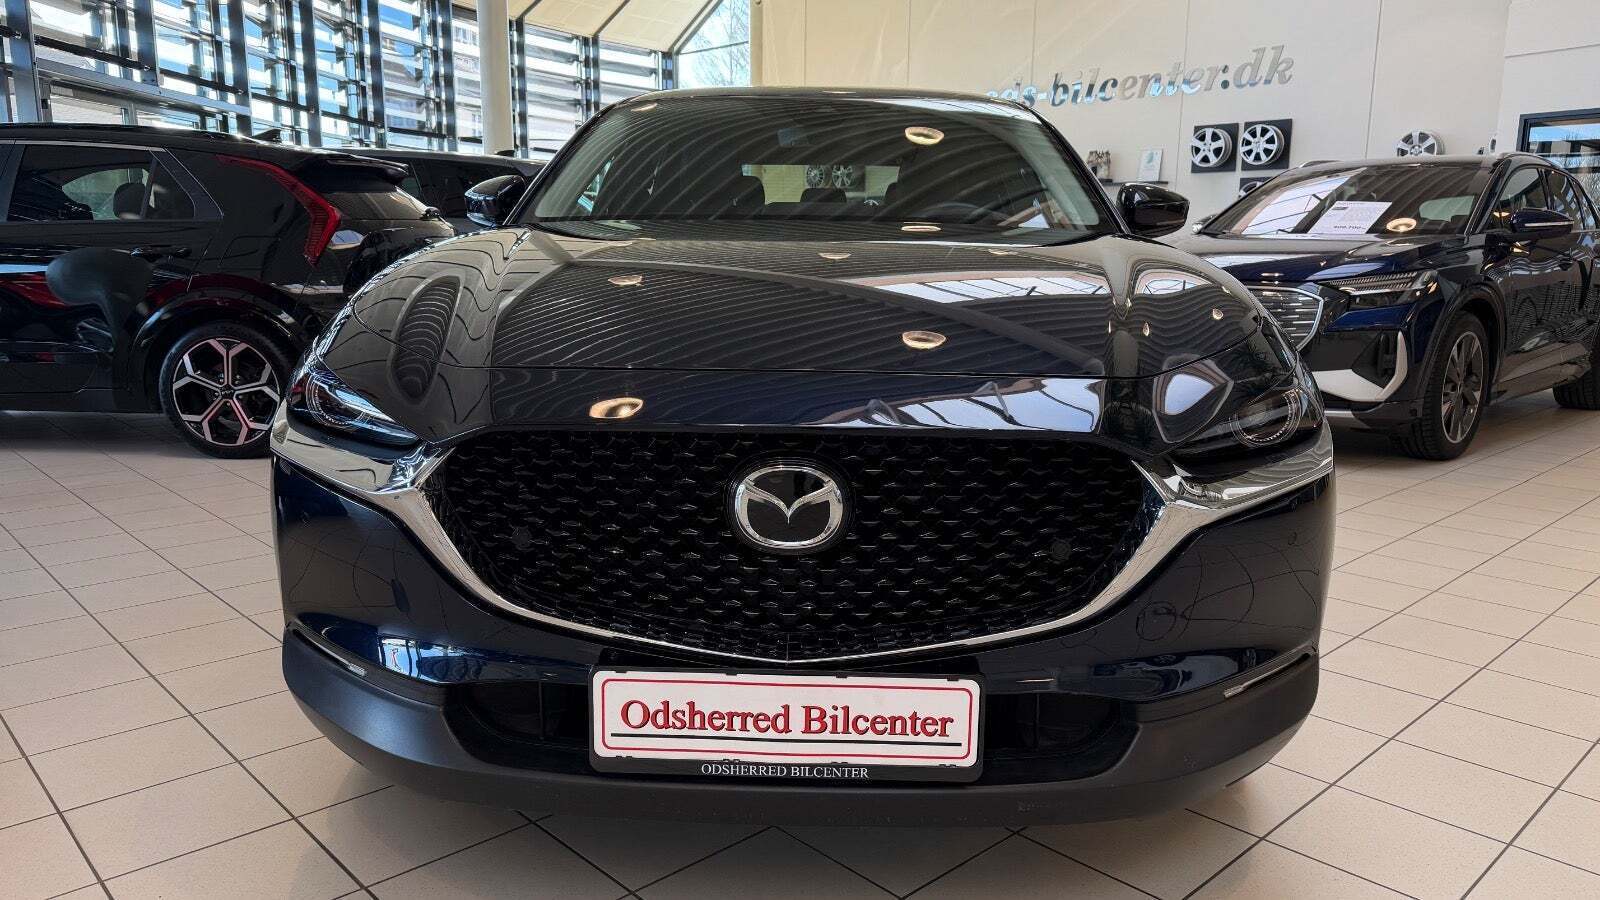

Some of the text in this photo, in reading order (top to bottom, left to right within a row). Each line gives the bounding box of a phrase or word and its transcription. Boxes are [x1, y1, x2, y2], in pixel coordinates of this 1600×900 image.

[620, 699, 954, 738] Odsherred Bilcenter
[701, 763, 869, 779] ODSHERRED BILCENTER
